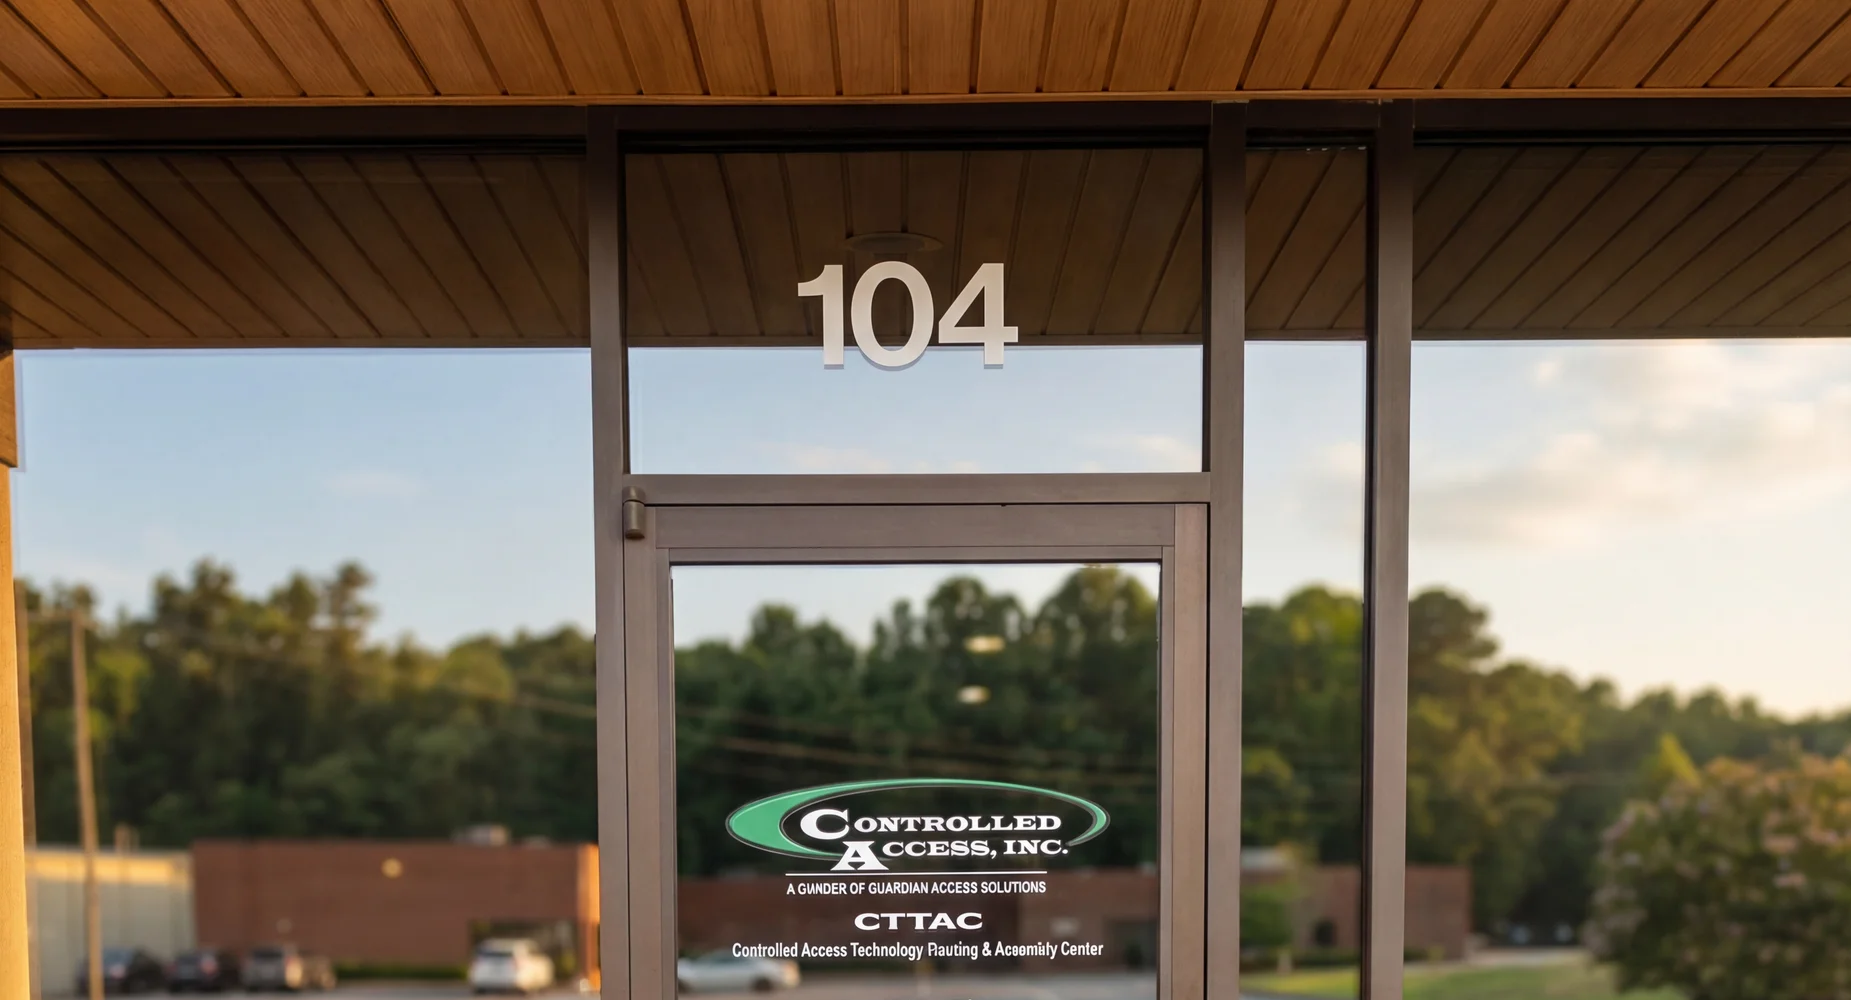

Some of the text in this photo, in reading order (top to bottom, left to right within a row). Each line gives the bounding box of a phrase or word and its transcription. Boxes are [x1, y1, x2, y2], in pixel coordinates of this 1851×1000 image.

[798, 260, 1019, 368] 104
[800, 808, 1062, 840] CONTROLLED
[829, 839, 1069, 871] ACCESS, INC.
[786, 883, 796, 895] A
[849, 882, 866, 895] OF
[868, 881, 929, 894] GUARDIAN
[930, 881, 978, 894] ACCESS
[980, 880, 1047, 894] SOLUTIONS
[854, 912, 983, 931] CTTAC
[732, 942, 798, 958] Controlled
[800, 942, 848, 958] Access
[850, 941, 924, 961] Technology
[981, 941, 992, 957] &
[1060, 941, 1104, 956] Center
